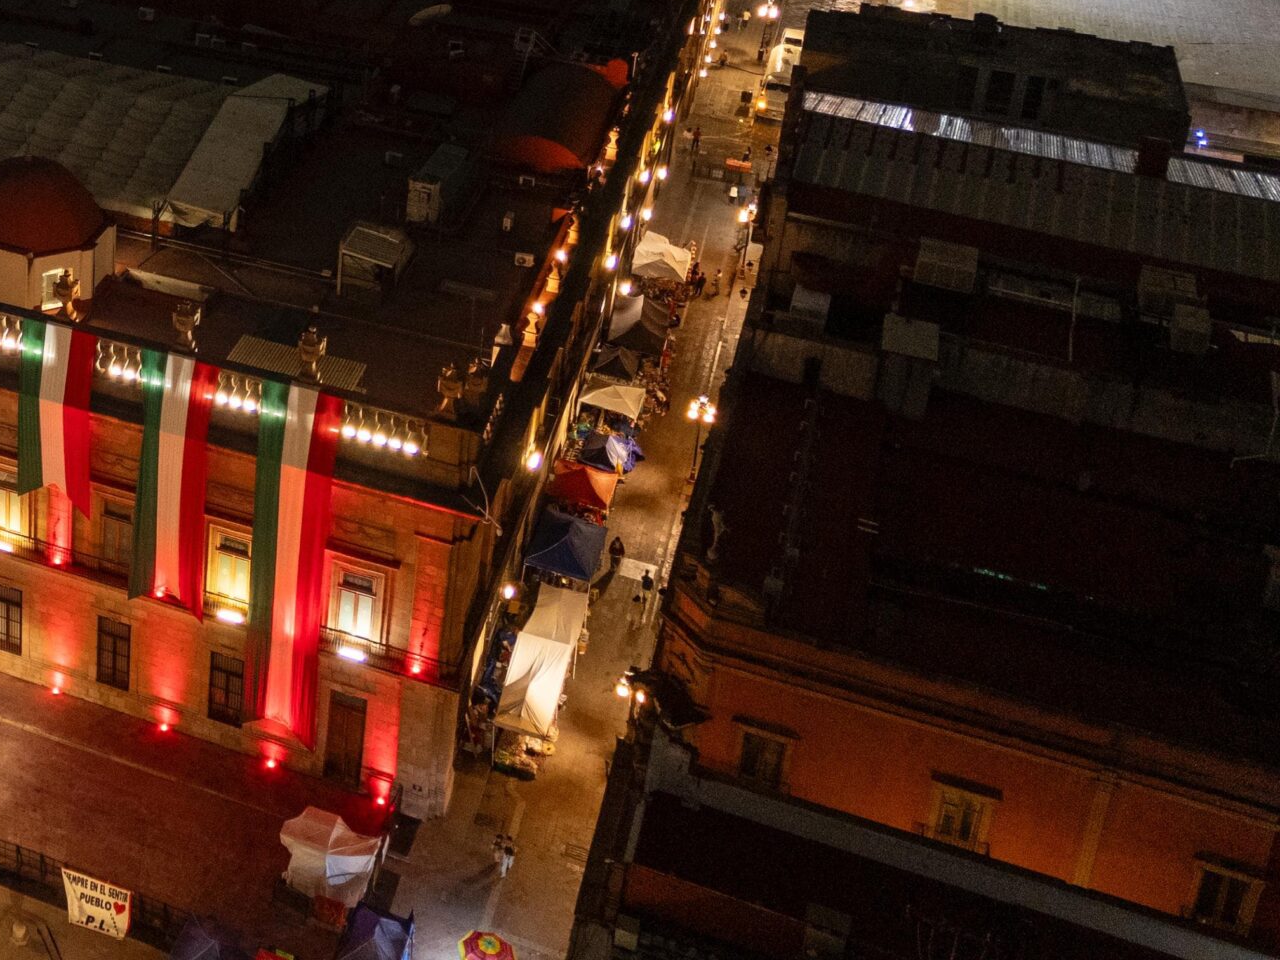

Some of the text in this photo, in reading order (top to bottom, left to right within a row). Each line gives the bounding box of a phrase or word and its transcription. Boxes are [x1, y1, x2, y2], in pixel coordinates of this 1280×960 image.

[90, 881, 99, 893] EN
[100, 884, 107, 896] EL
[80, 892, 112, 911] PUEBLO
